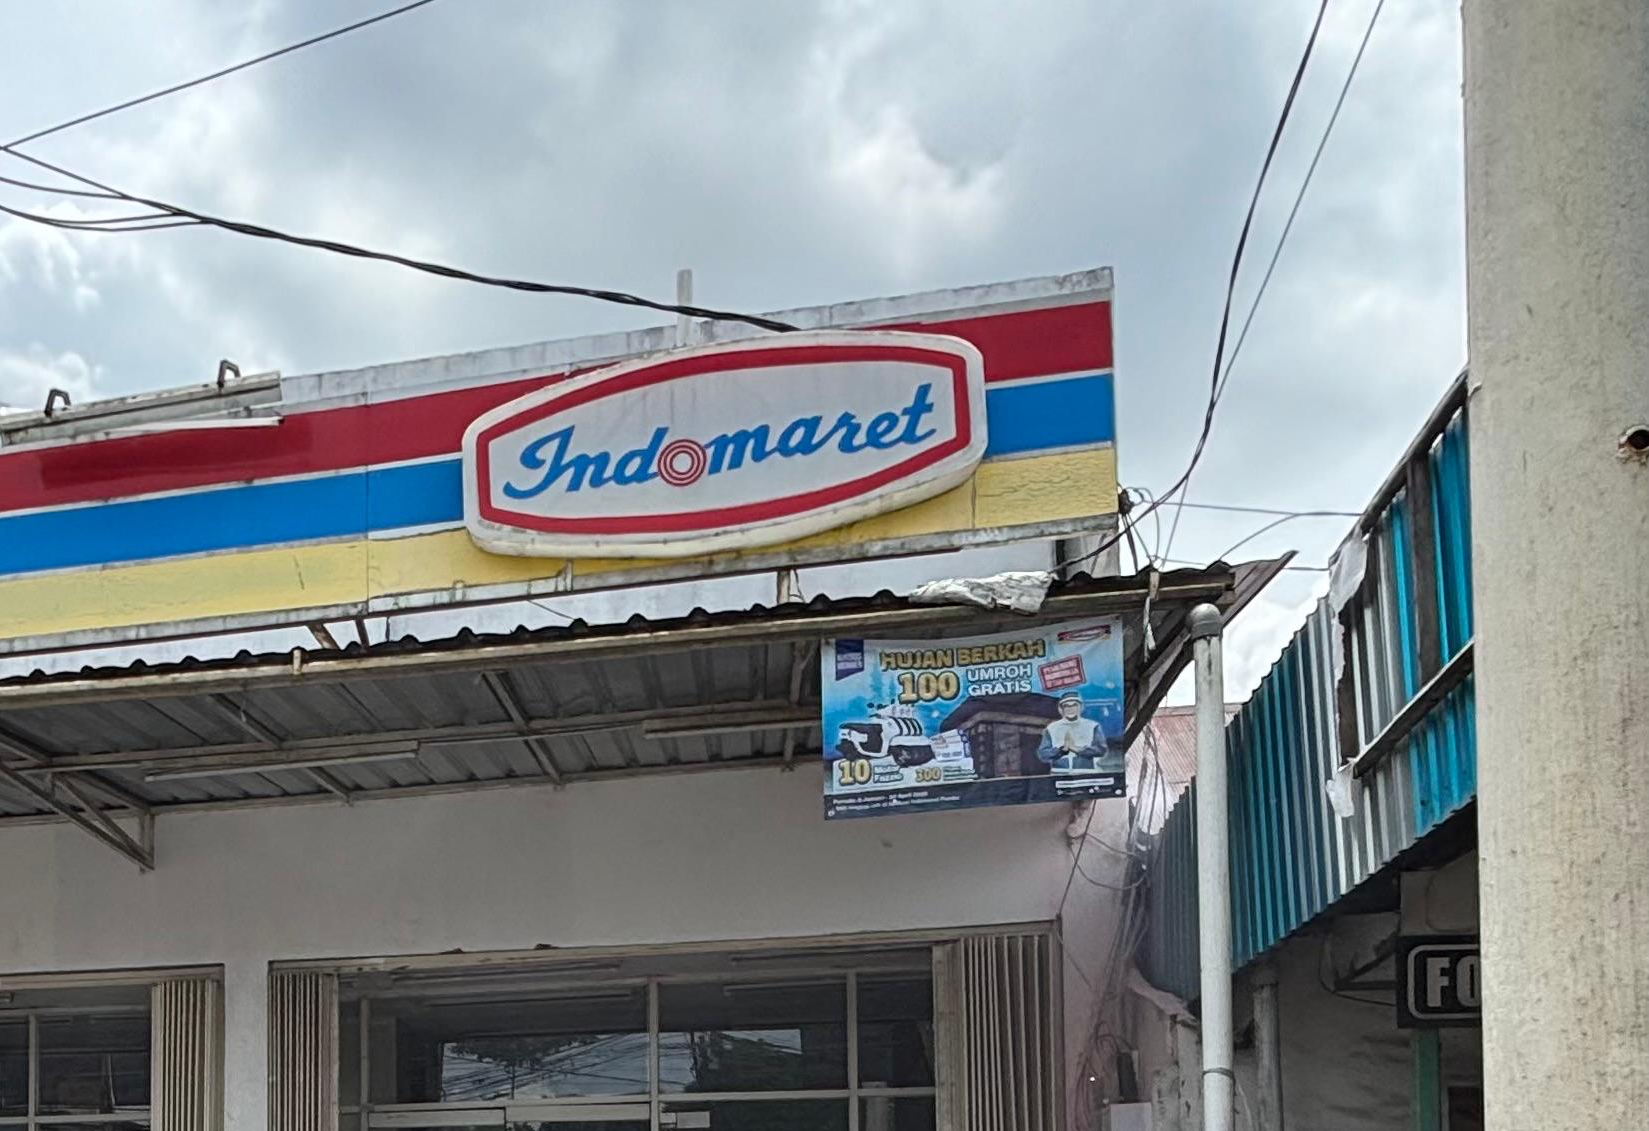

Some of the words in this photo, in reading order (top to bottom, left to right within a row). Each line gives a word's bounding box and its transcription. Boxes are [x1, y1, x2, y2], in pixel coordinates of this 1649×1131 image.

[503, 383, 937, 500] Indomaret
[880, 650, 953, 671] HUJAN
[957, 639, 1045, 666] BERKAH
[967, 663, 1032, 681] UMROH
[898, 671, 960, 703] 100
[968, 680, 1032, 696] GRATIS
[839, 758, 872, 785] 10
[914, 767, 941, 782] 300
